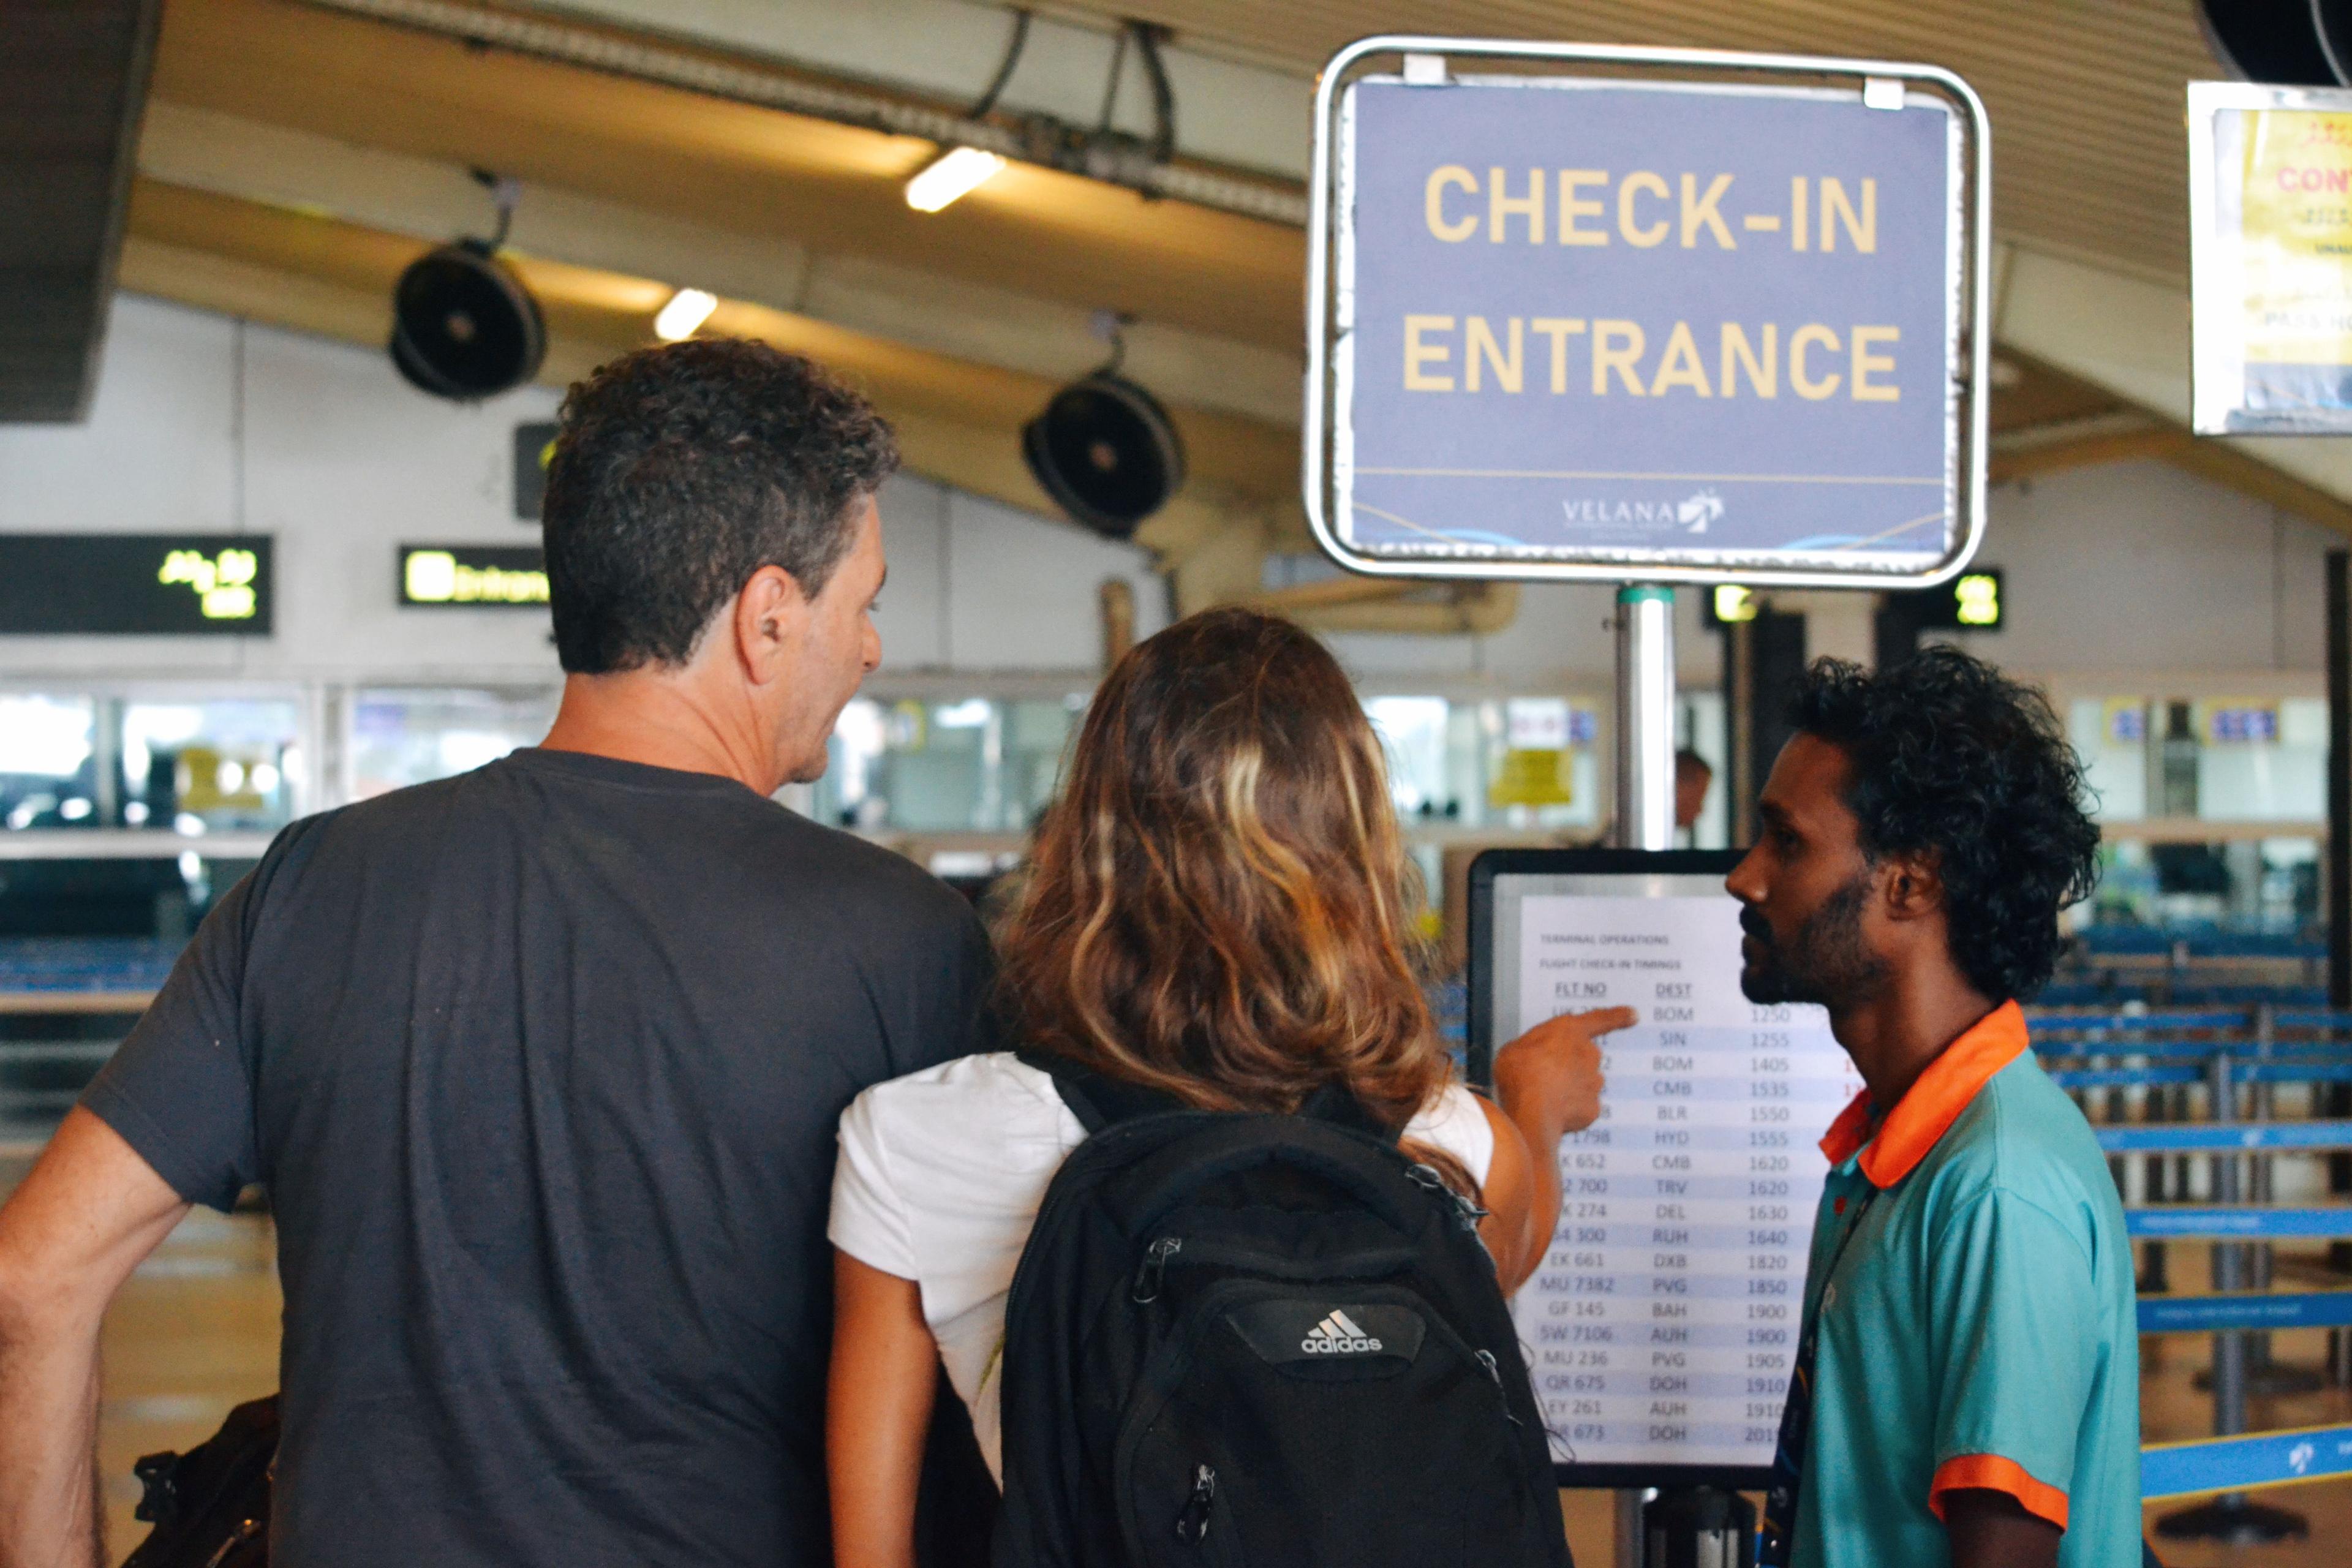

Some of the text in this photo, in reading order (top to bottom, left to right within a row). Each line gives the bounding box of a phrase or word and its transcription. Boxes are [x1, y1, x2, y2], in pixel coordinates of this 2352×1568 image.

[2277, 166, 2352, 194] CON
[1424, 165, 1878, 254] CHECK-IN
[1402, 314, 1901, 402] ENTRANCE
[1561, 498, 1676, 521] VELANA
[1540, 933, 1669, 946] TERMINAL OPERATIONS
[1539, 958, 1576, 970] FLIGHT
[1634, 959, 1681, 970] TIMINGS
[1555, 982, 1692, 1000] FLT NO DEST
[1653, 1006, 1694, 1022] BOM
[1751, 1007, 1791, 1023] 1250
[1659, 1031, 1789, 1049] SIN 1255
[1653, 1056, 1789, 1073] BOM 1405
[1653, 1080, 1789, 1098] CMB 1535
[1657, 1105, 1790, 1123] BLR 1550
[1654, 1131, 1689, 1147] HYD
[1750, 1131, 1789, 1148] 1555
[1575, 1153, 1605, 1169] 652
[1652, 1155, 1691, 1170] CMB
[1749, 1156, 1789, 1172] 1620
[1578, 1178, 1608, 1194] 700
[1656, 1180, 1688, 1195] TRV
[1749, 1180, 1789, 1197] 1620
[1577, 1203, 1607, 1218] 274
[1656, 1204, 1686, 1220] DEL
[1749, 1205, 1789, 1222] 1630
[1653, 1229, 1689, 1245] RUH
[1749, 1230, 1788, 1246] 1640
[1550, 1252, 1787, 1270] EK 661 DXB 1820
[1540, 1276, 1570, 1292] MU
[1653, 1278, 1688, 1294] PVG
[1748, 1279, 1787, 1295] 1850
[1575, 1301, 1605, 1316] 145
[1652, 1303, 1687, 1318] BAH
[1748, 1304, 1787, 1319] 1900
[1573, 1325, 1613, 1342] 7106
[1651, 1327, 1688, 1343] AUH
[1747, 1329, 1787, 1344] 1900
[1301, 1336, 1382, 1354] adidas
[1544, 1350, 1574, 1366] MU
[1652, 1352, 1686, 1368] PVG
[1747, 1354, 1785, 1370] 1905
[1649, 1376, 1687, 1393] DOH
[1747, 1378, 1786, 1394] 1910
[1573, 1399, 1602, 1415] 261
[1649, 1401, 1687, 1417] AUH
[1649, 1425, 1686, 1441] DOH
[1745, 1427, 1779, 1444] 201
